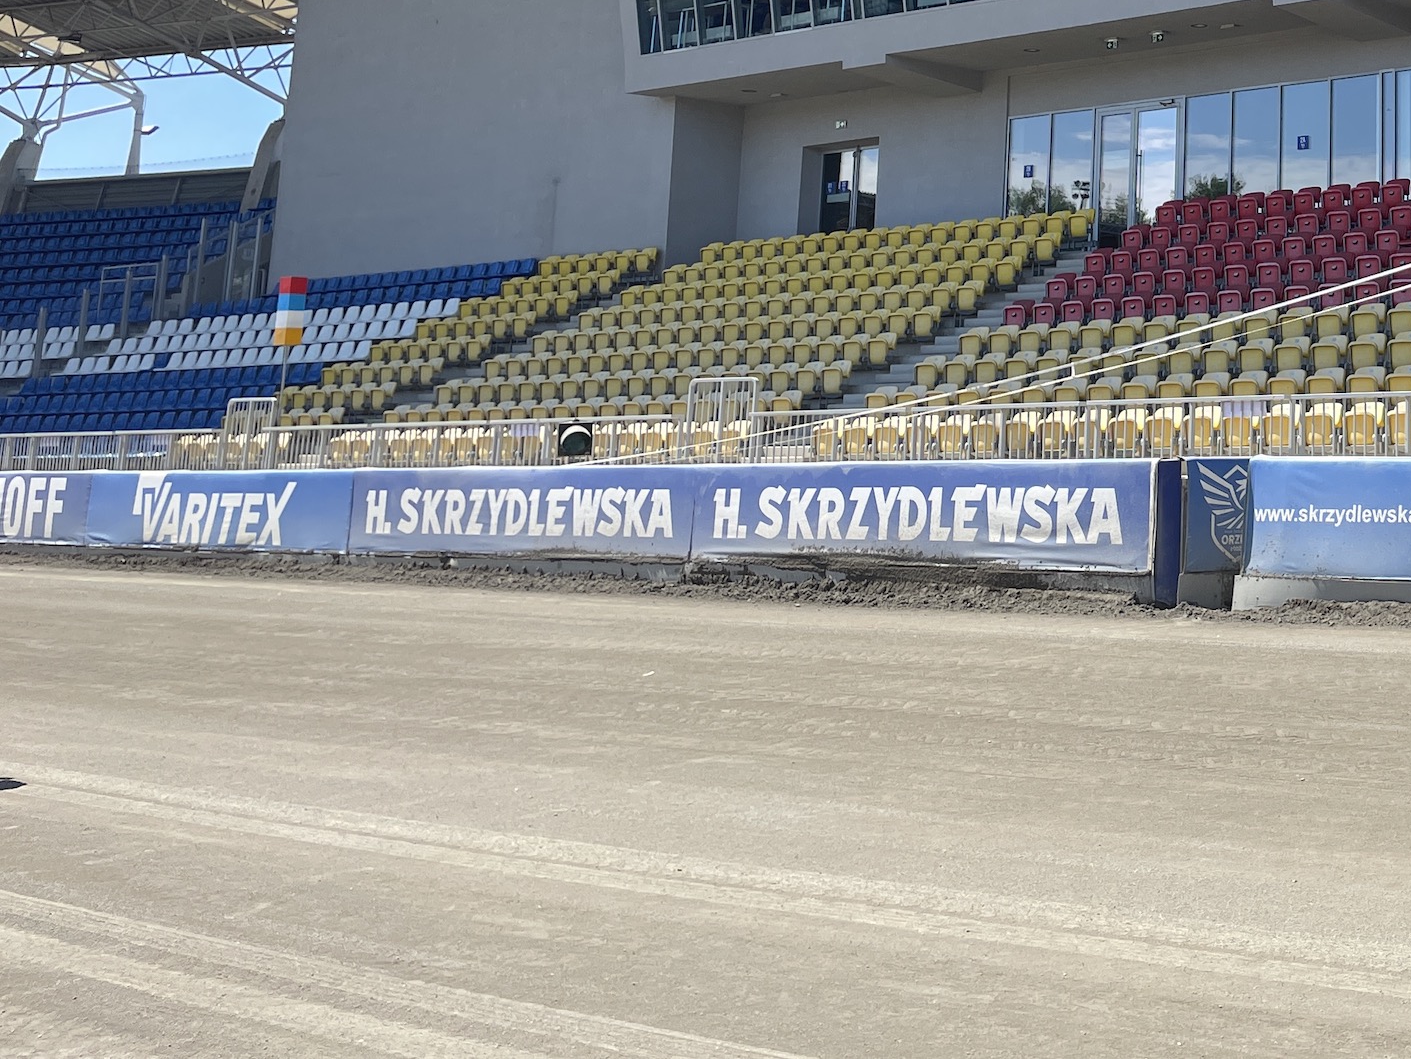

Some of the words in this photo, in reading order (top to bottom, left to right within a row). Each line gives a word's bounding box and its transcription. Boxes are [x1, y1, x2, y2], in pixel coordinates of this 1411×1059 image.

[0, 475, 68, 539] OFF
[137, 477, 298, 547] VARITEX
[365, 489, 392, 535] H.
[396, 485, 673, 539] SKRZYDLEWSKA
[713, 487, 747, 539] H.
[754, 483, 1122, 545] SKRZYDLEWSKA
